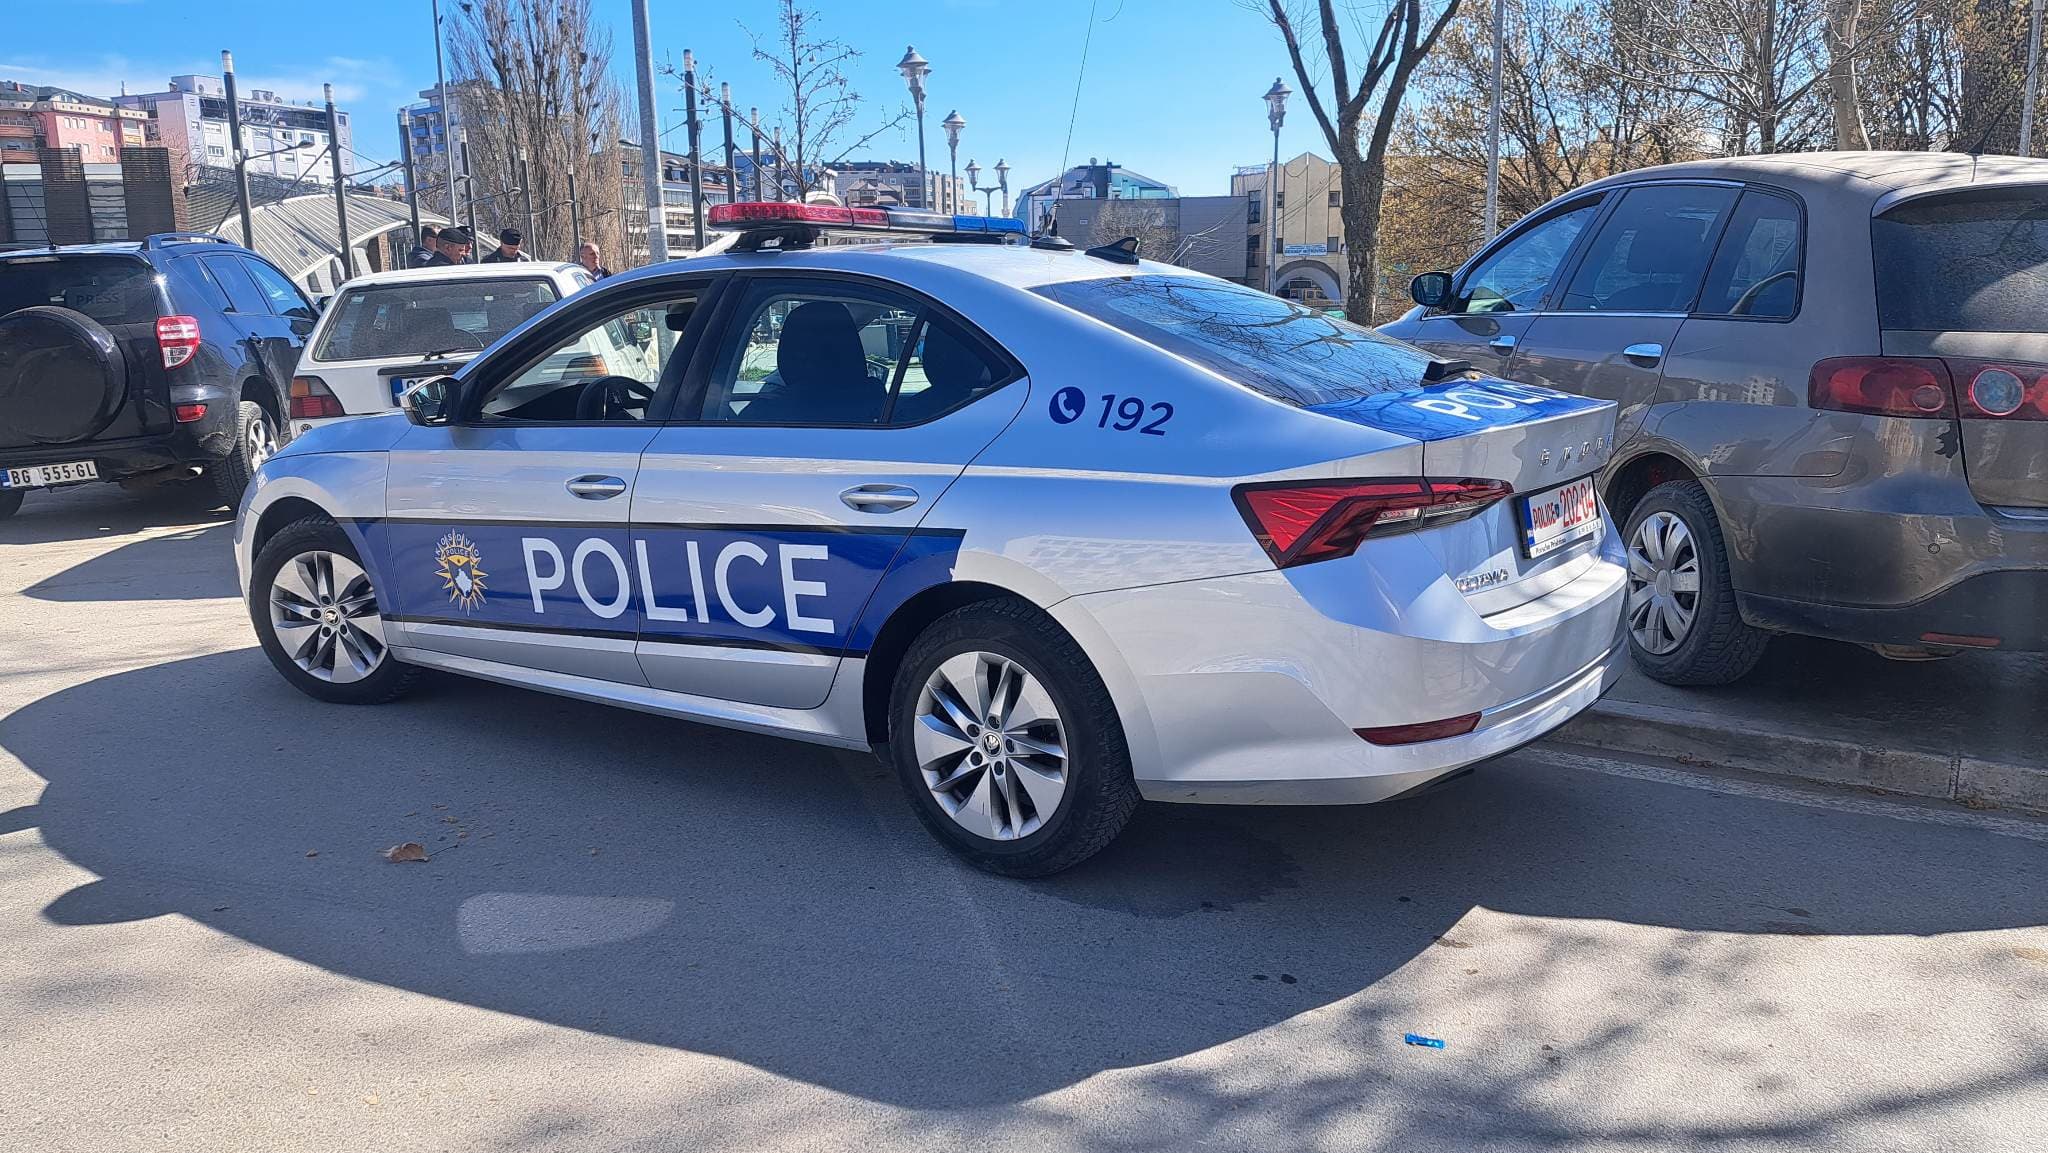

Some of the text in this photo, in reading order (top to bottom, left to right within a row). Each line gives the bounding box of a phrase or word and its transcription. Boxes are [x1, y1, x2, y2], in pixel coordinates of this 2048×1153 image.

[76, 292, 120, 304] PRESS
[1098, 394, 1174, 436] 192
[11, 469, 31, 485] BG
[1533, 502, 1557, 530] POLICE
[446, 547, 469, 557] POLICE
[522, 537, 835, 634] POLICE
